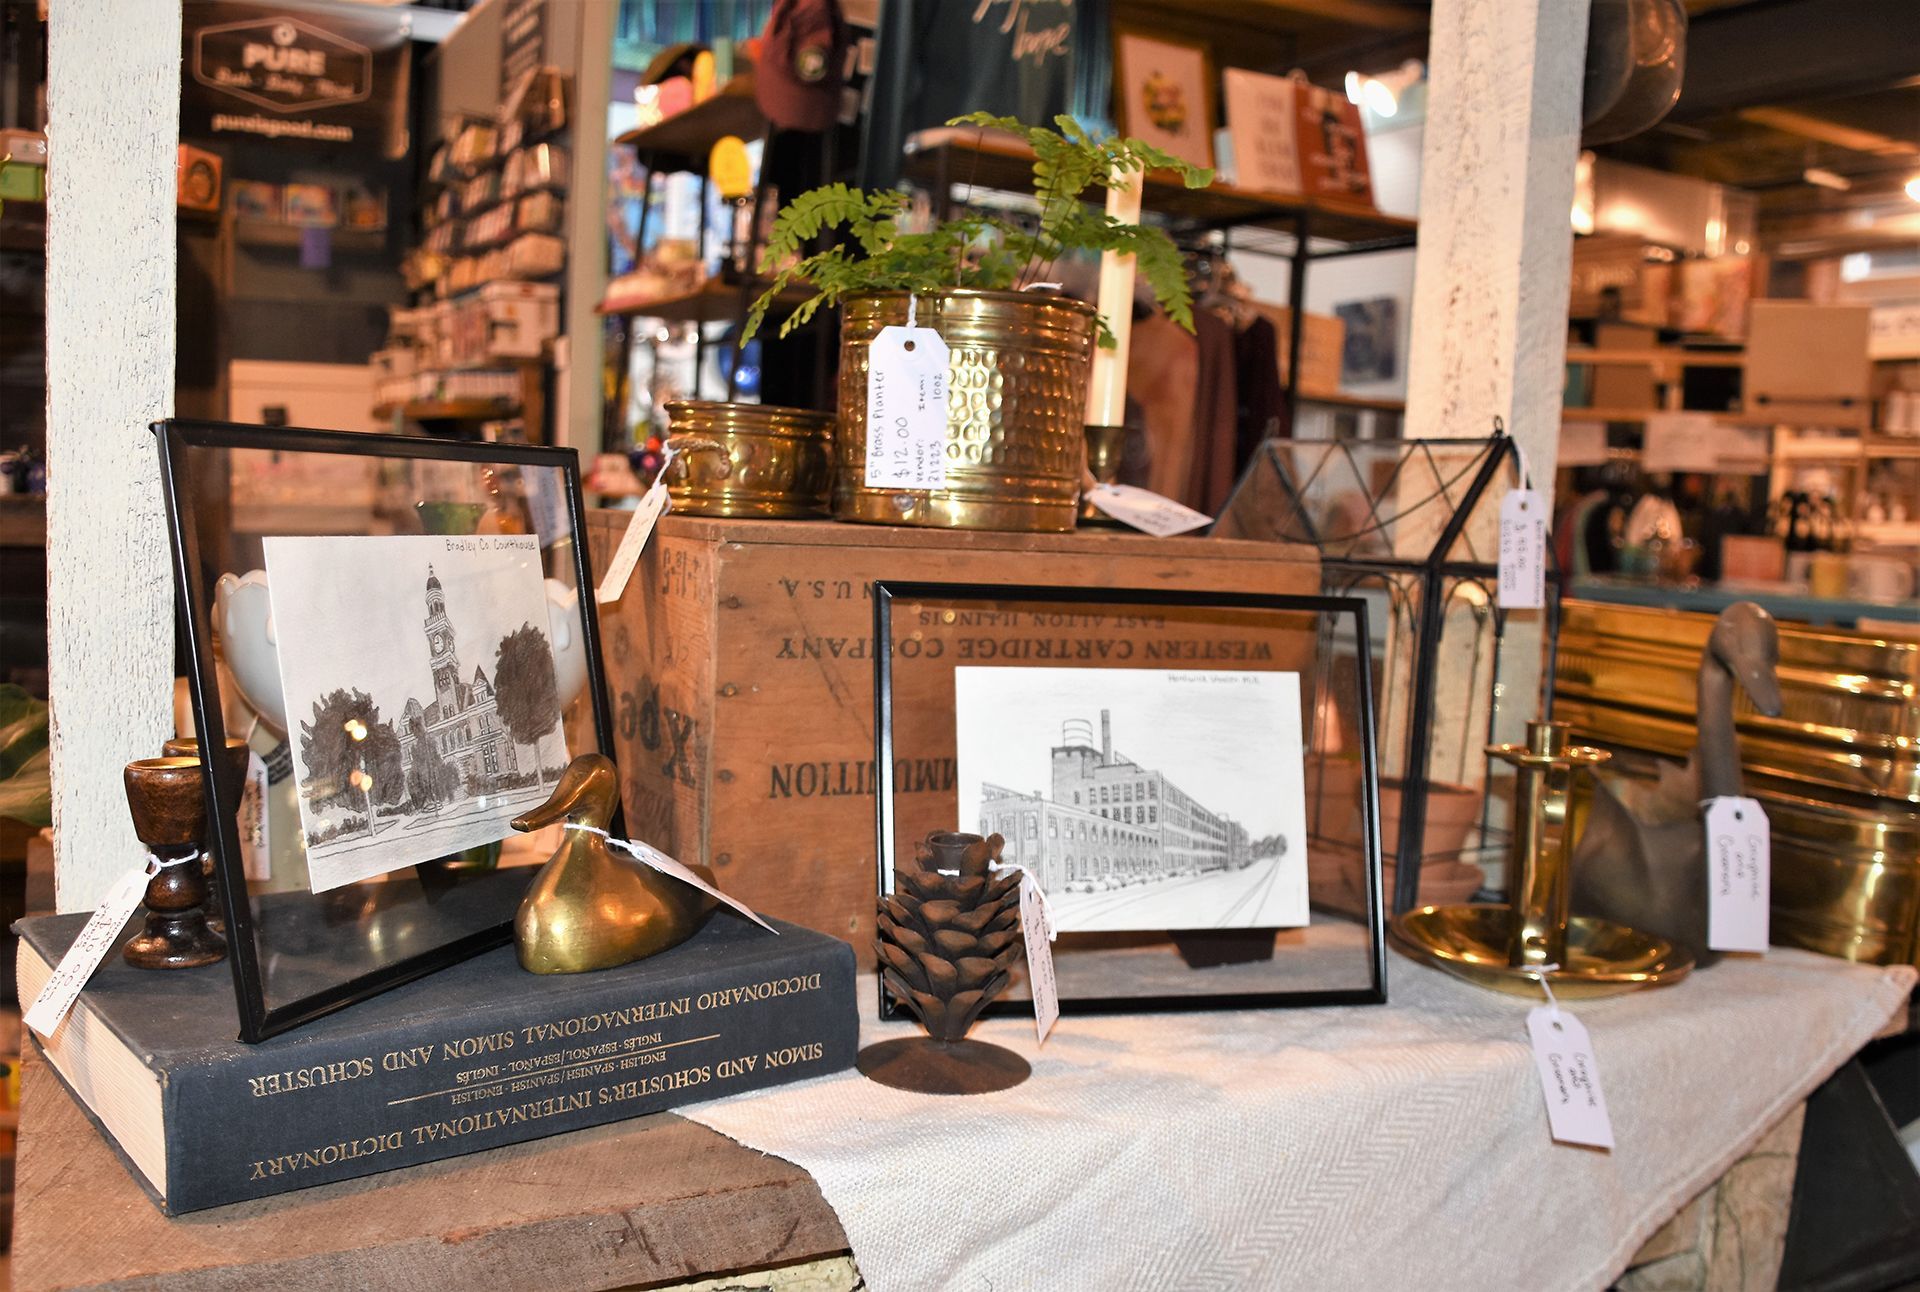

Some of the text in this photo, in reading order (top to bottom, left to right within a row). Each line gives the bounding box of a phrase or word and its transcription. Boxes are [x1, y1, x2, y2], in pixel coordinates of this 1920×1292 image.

[243, 42, 324, 75] PURE
[1011, 8, 1071, 64] hope
[873, 370, 884, 418] Planter
[871, 426, 883, 456] Brass
[891, 416, 911, 478] $12.00
[928, 373, 942, 481] 21223 1002
[445, 538, 476, 555] Bradley
[493, 538, 535, 550] Courthouse
[1114, 613, 1165, 629] EAST
[775, 636, 1273, 659] WESTERN CARTRIDGE COPANY
[610, 674, 697, 788] Xpe
[62, 914, 113, 990] $10.00
[248, 971, 820, 1099] DICCIONARIO INTERNACIONAL SIMON AND SCHUSTER
[620, 1050, 665, 1069] ENGLISH
[250, 1041, 822, 1180] SIMON AND SCHUSTER'S INTERNATIONAL DICTIONARY
[451, 1084, 502, 1104] ENGLISH
